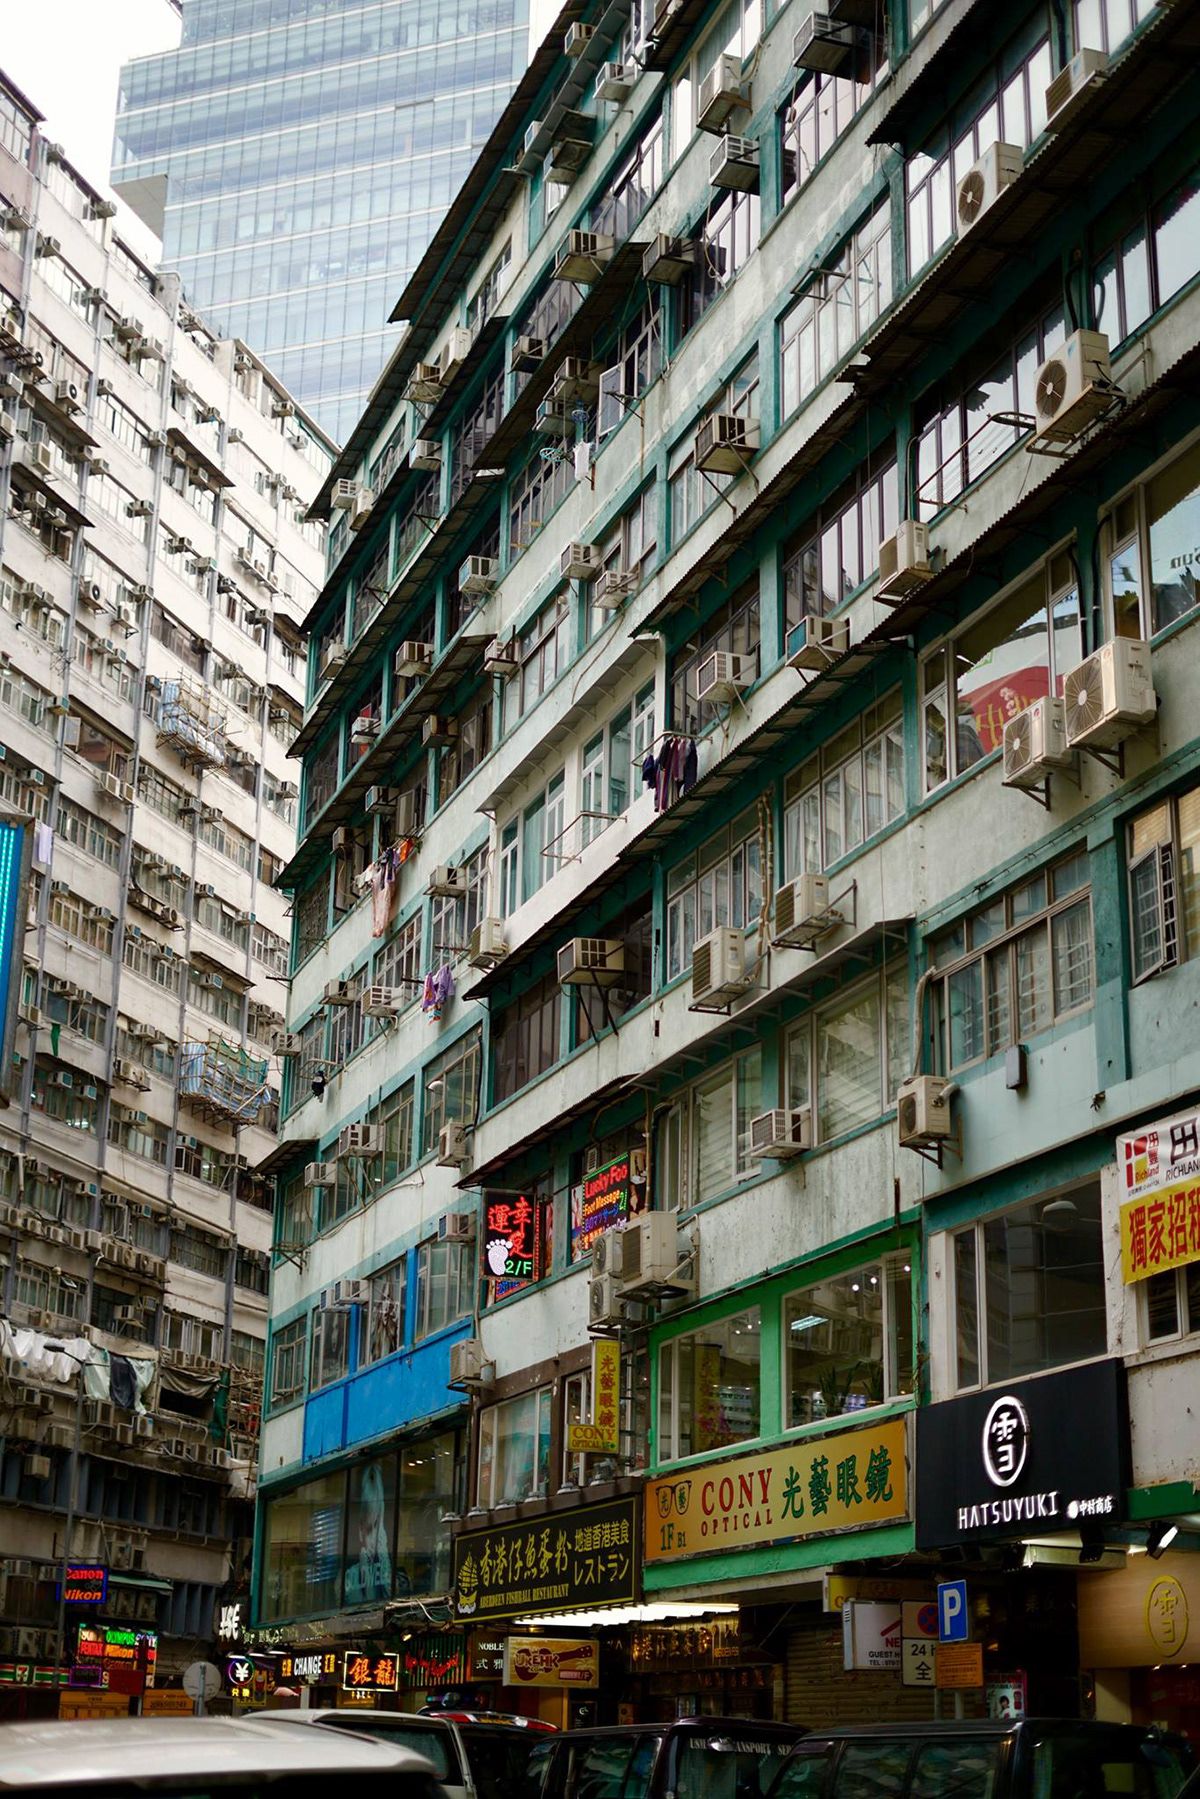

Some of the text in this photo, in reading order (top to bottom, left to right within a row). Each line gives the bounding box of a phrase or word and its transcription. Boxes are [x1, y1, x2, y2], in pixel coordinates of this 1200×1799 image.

[506, 1260, 532, 1276] 2/F
[572, 1427, 615, 1441] CONY
[701, 1468, 773, 1516] CONY
[781, 1445, 894, 1520] 光藝眼鏡
[701, 1509, 773, 1537] OPTICAL
[958, 1491, 1059, 1530] HATSUYUKI
[574, 1519, 630, 1553] 地道香港美食
[480, 1528, 572, 1588] 香港仔魚蛋粉
[574, 1552, 630, 1586] レストラン
[480, 1593, 505, 1609] ABERDEEN
[532, 1583, 570, 1601] RESTAURANT
[944, 1588, 961, 1636] P
[294, 1655, 322, 1676] CHANGE
[911, 1644, 926, 1656] 24
